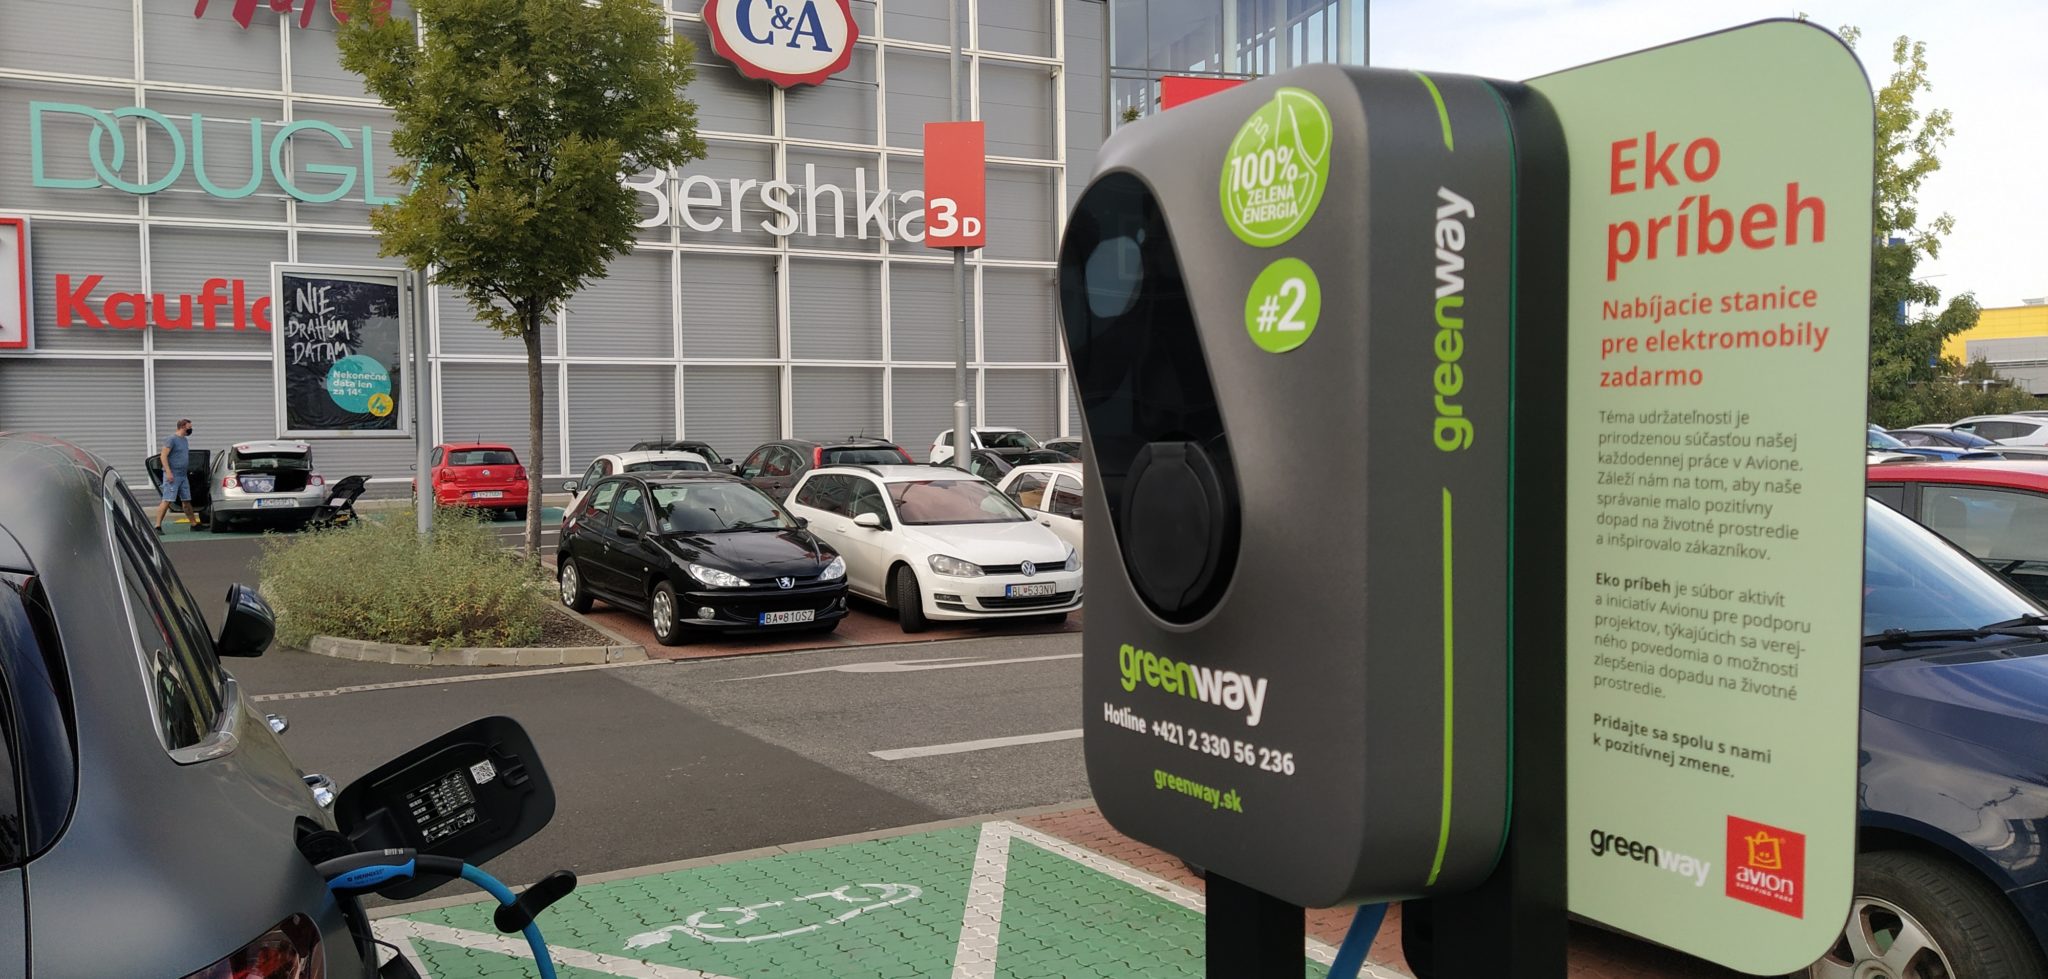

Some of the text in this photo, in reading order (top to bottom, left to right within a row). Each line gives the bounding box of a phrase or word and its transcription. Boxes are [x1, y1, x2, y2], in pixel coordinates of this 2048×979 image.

[736, 0, 833, 52] C&A
[1231, 145, 1298, 192] 100%
[1610, 131, 1721, 195] Eko
[1247, 182, 1294, 206] ZELENÁ
[1242, 203, 1298, 225] ENERGIA
[1607, 182, 1826, 281] príbeh
[296, 282, 335, 315] NIE
[1257, 278, 1306, 332] #2
[1602, 286, 1818, 323] Nabíjacie stanice
[288, 315, 350, 341] DRAHÝM
[1434, 186, 1474, 451] greenway
[1602, 322, 1829, 359] pre elektromobily
[1600, 366, 1703, 387] zadarmo
[1600, 410, 1749, 428] Téma udržateľnosti je
[1599, 432, 1798, 452] prirodzenou súčasťou našej
[1598, 452, 1803, 472] každodennej práce v Avione.
[1597, 472, 1801, 495] Záleží nám na tom, aby naše
[1597, 494, 1773, 519] správanie malo pozitívny
[1597, 513, 1799, 539] dopad na životné prostredie
[1596, 534, 1770, 560] a inšpirovalo zákazníkov.
[1596, 572, 1785, 607] Eko príbeh je súbor aktivít
[1595, 595, 1811, 633] a iniciatív Avionu pre podporu
[1595, 614, 1806, 659] projektov, týkajúcich sa verej-
[1595, 634, 1798, 677] ného povedomia o možnosti
[1119, 643, 1267, 726] greenway
[1594, 655, 1797, 700] zlepšenia dopadu na životné
[1594, 675, 1665, 698] prostredie.
[1104, 703, 1295, 775] Hotline +421 2 330 56 236
[1594, 713, 1771, 763] Pridajte sa spolu s nami
[1594, 734, 1734, 778] k pozitívnej zmene.
[1154, 769, 1243, 813] greenway.sk
[1590, 829, 1710, 887] greenway
[1736, 866, 1793, 895] avion
